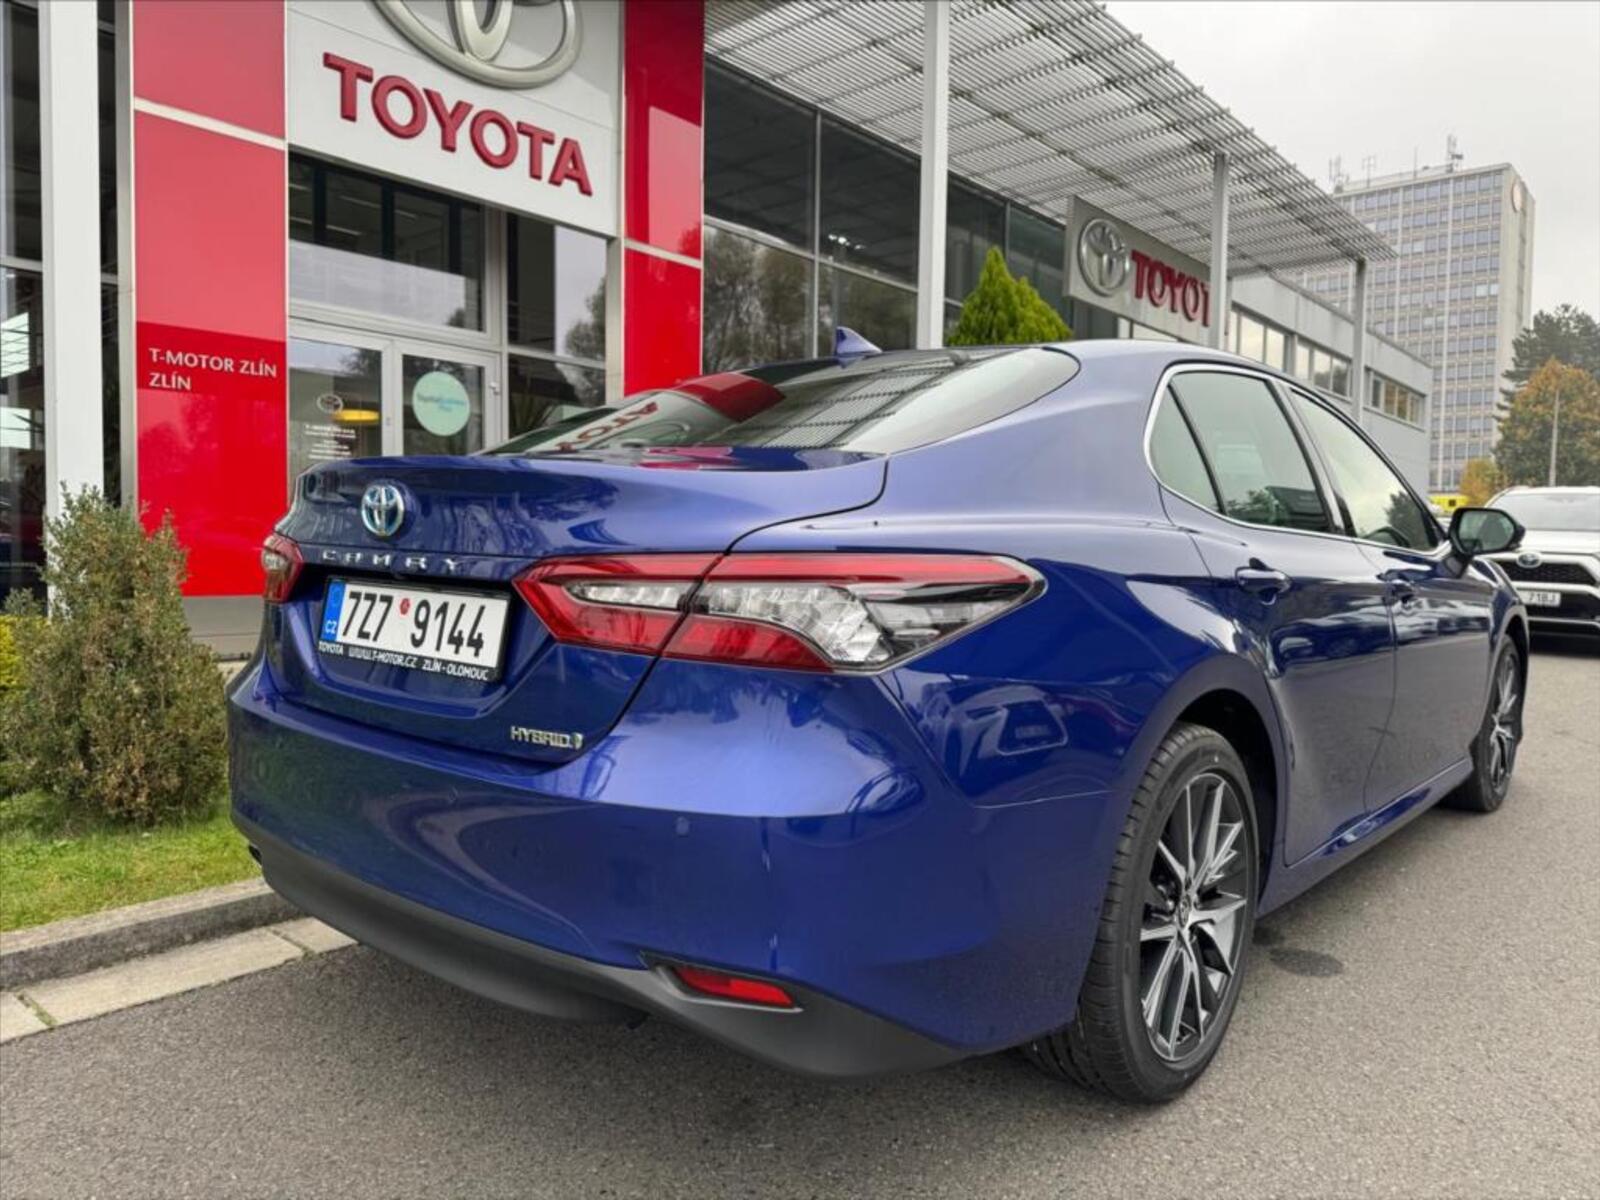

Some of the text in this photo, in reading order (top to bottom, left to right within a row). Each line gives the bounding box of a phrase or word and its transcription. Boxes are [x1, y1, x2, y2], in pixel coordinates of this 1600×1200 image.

[323, 52, 593, 197] TOYOTA
[1131, 249, 1210, 327] TOYOT
[148, 347, 277, 378] T-MOTOR ZLÍN
[149, 371, 191, 391] ZLÍN
[322, 551, 464, 571] CAMRY
[324, 620, 337, 635] CZ
[342, 591, 486, 657] 7Z7 9144
[510, 726, 570, 748] HYBRID
